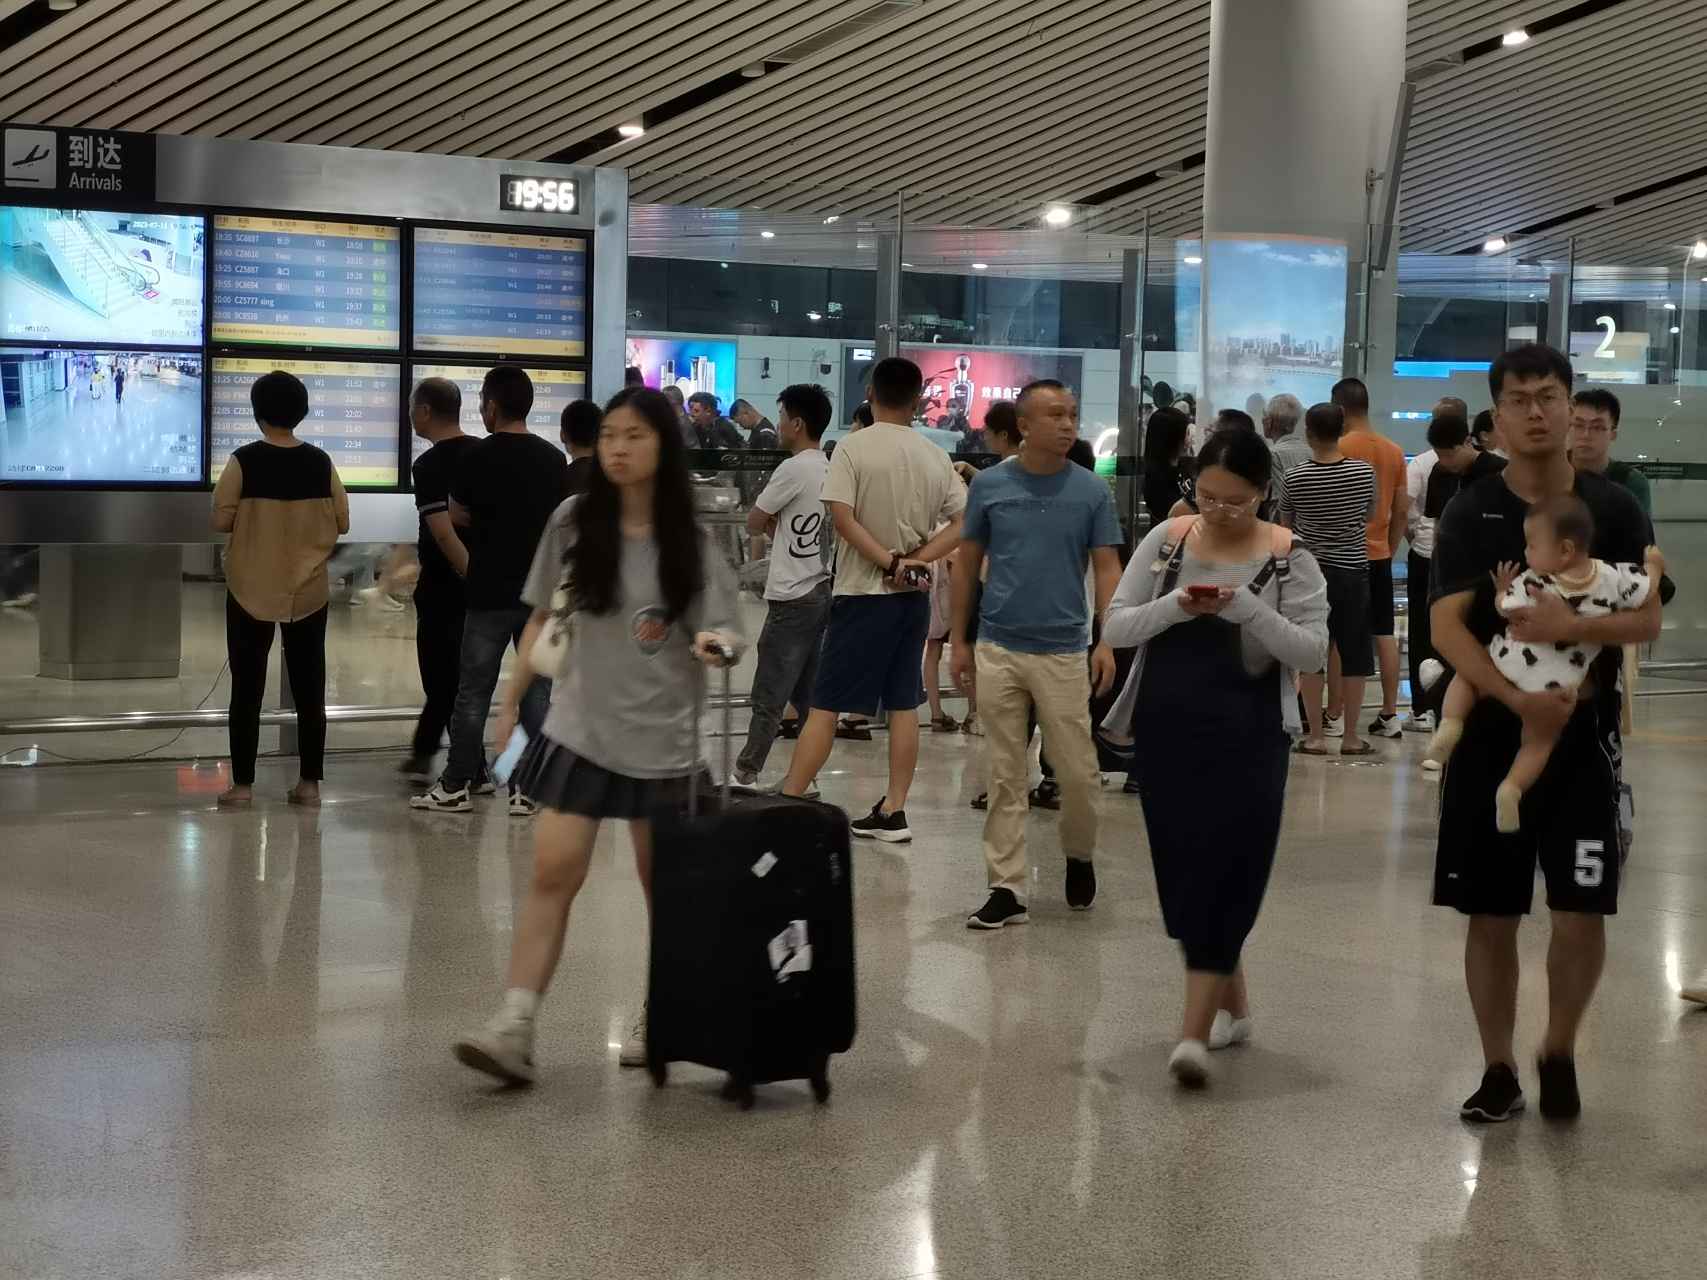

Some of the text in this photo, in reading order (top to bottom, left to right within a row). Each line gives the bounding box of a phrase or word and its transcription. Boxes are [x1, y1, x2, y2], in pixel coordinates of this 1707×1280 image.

[69, 135, 122, 170] 到达
[69, 171, 122, 191] Arrivals
[515, 179, 575, 211] 19:56
[132, 220, 168, 229] 2023-07-14
[215, 233, 232, 241] 18:35
[277, 236, 291, 245] 长沙
[315, 239, 326, 247] W1
[346, 241, 363, 250] 18:59
[215, 248, 232, 257] 18:40
[235, 249, 259, 258] CZ8616
[275, 252, 291, 260] Yiwu
[315, 254, 325, 263] W1
[346, 256, 363, 265] 20:10
[215, 264, 232, 273] 19:25
[276, 267, 290, 276] 海口
[315, 270, 325, 278] W1
[346, 271, 363, 280] 19:28
[507, 266, 518, 274] W1
[214, 280, 232, 288] 19:55
[315, 285, 325, 294] W1
[346, 287, 363, 295] 19:32
[214, 295, 231, 303] 20:00
[234, 296, 259, 305] CZ5777
[260, 297, 275, 308] xing
[315, 300, 325, 309] W1
[345, 302, 363, 310] 19:37
[213, 311, 231, 319] 20:00
[234, 312, 258, 320] 9C8538
[314, 316, 325, 324] W1
[345, 317, 363, 326] 19:43
[507, 312, 517, 320] W1
[184, 319, 198, 329] 到达
[507, 327, 517, 335] W1
[1593, 315, 1616, 359] 2
[213, 375, 231, 383] 21:25
[314, 379, 325, 387] W1
[345, 380, 363, 388] 21:52
[535, 386, 552, 394] 22:49
[213, 391, 231, 399] 21:50
[233, 392, 251, 400] PN63
[314, 394, 325, 402] W1
[345, 395, 362, 403] 22:01
[535, 400, 551, 408] 23:15
[212, 406, 231, 415] 22:05
[314, 409, 325, 417] W1
[345, 409, 362, 418] 22:02
[535, 415, 551, 423] 23:07
[212, 422, 230, 430] 22:10
[314, 424, 325, 433] W1
[344, 425, 362, 433] 21:42
[212, 437, 230, 446] 22:45
[313, 440, 324, 448] W1
[344, 440, 362, 448] 22:34
[169, 444, 198, 454] 航站楼
[178, 455, 197, 464] 到达
[344, 455, 362, 463] 22:53
[1574, 839, 1605, 887] 5
